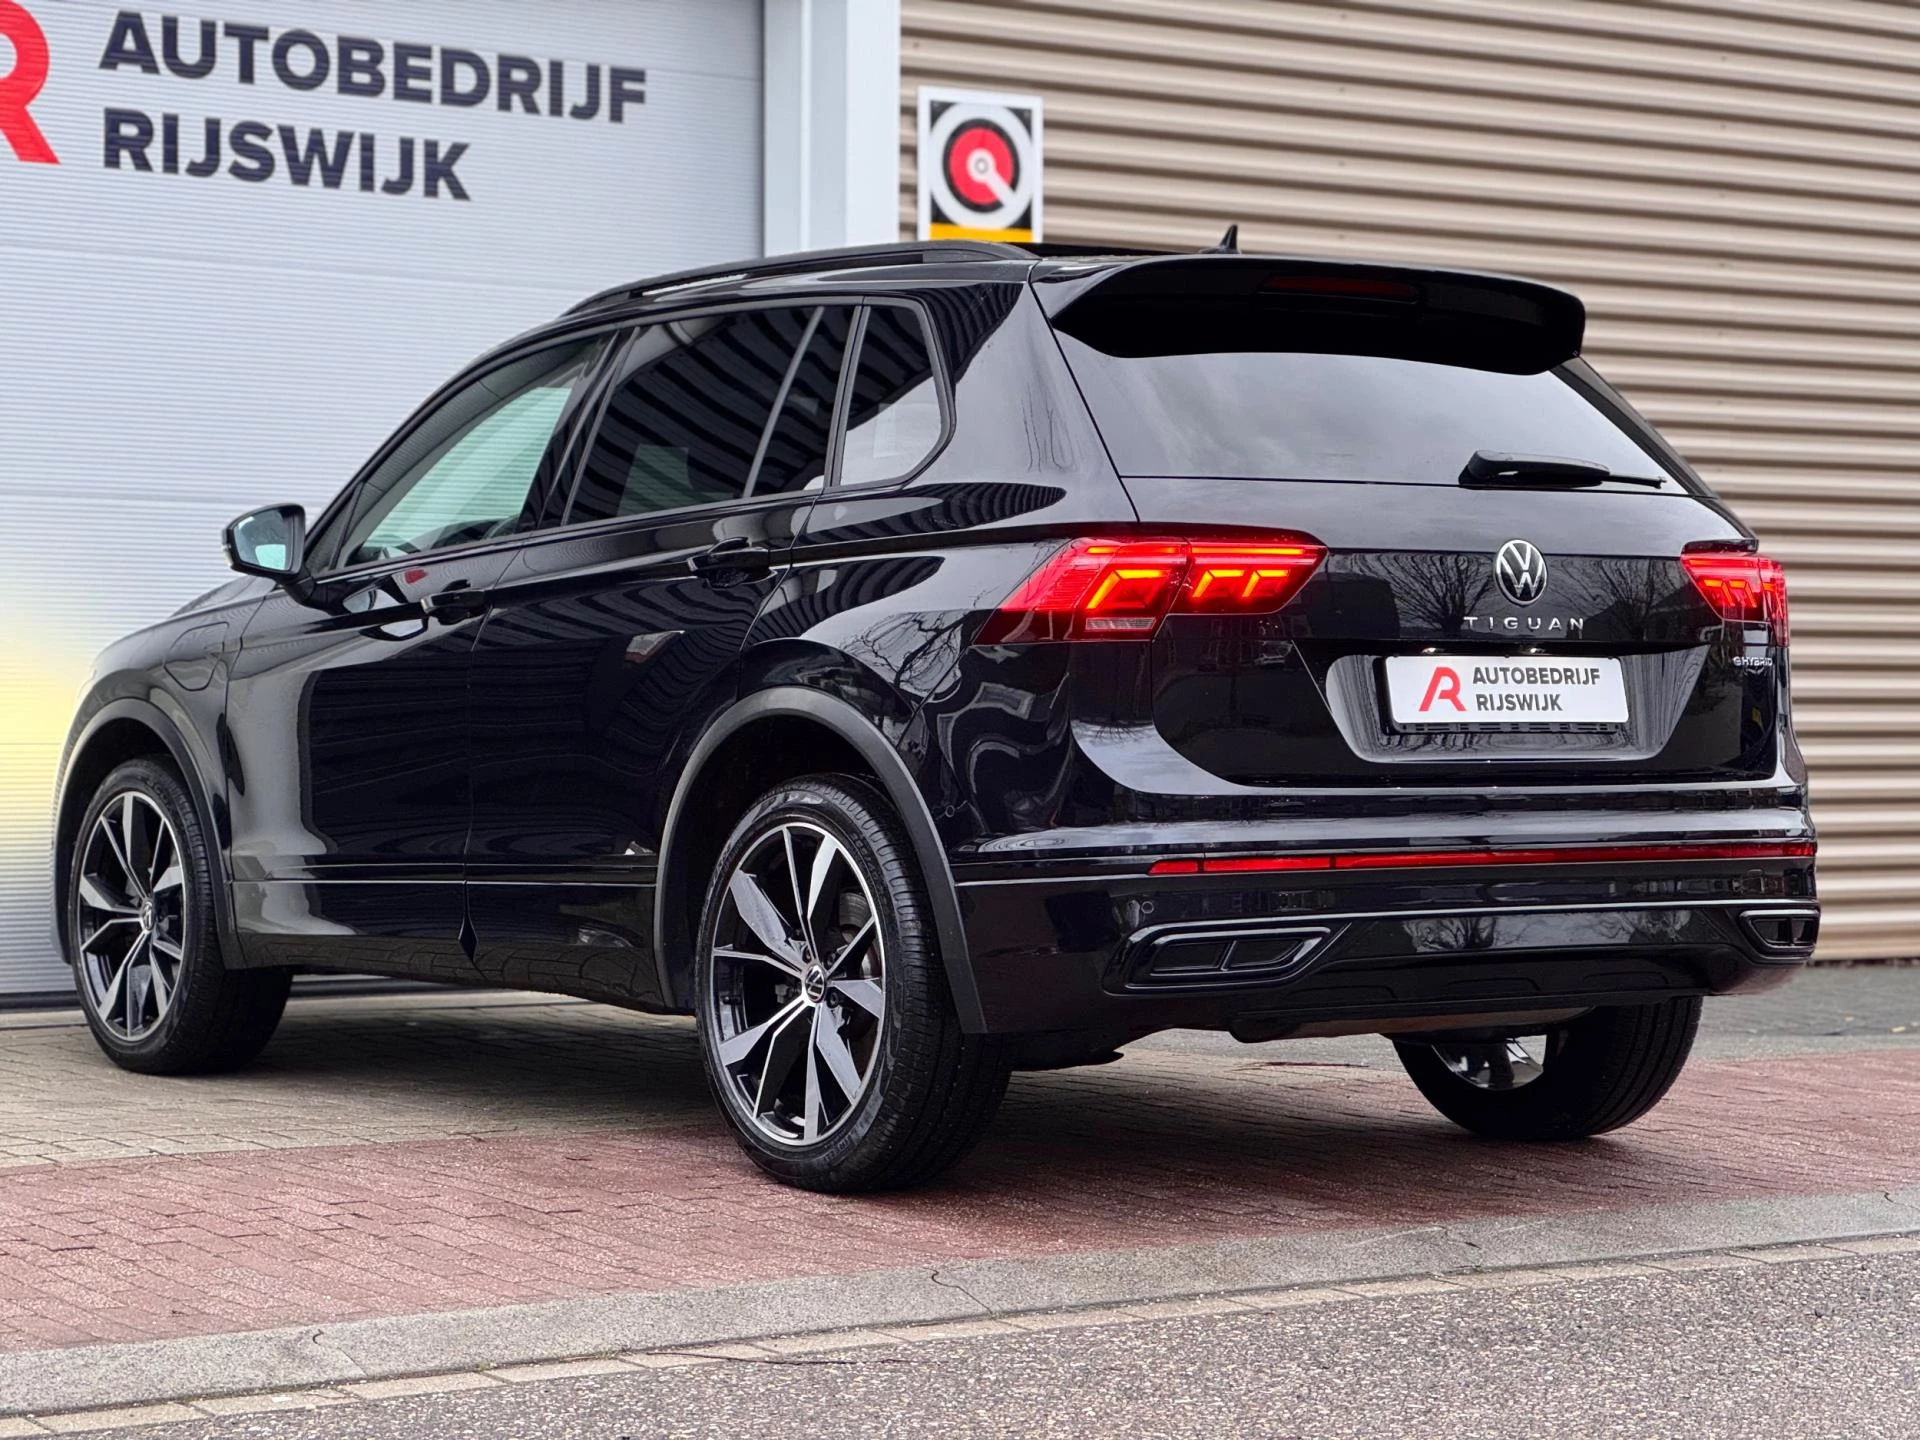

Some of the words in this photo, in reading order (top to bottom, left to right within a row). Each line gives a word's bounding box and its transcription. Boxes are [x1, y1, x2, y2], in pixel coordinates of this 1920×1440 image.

[100, 11, 646, 123] AUTOBEDRIJF
[103, 107, 471, 201] RIJSWIJK
[1463, 616, 1584, 631] TIGUAN
[1472, 666, 1600, 685] AUTOBEDRIJF
[1475, 693, 1563, 711] RIJSWIJK
